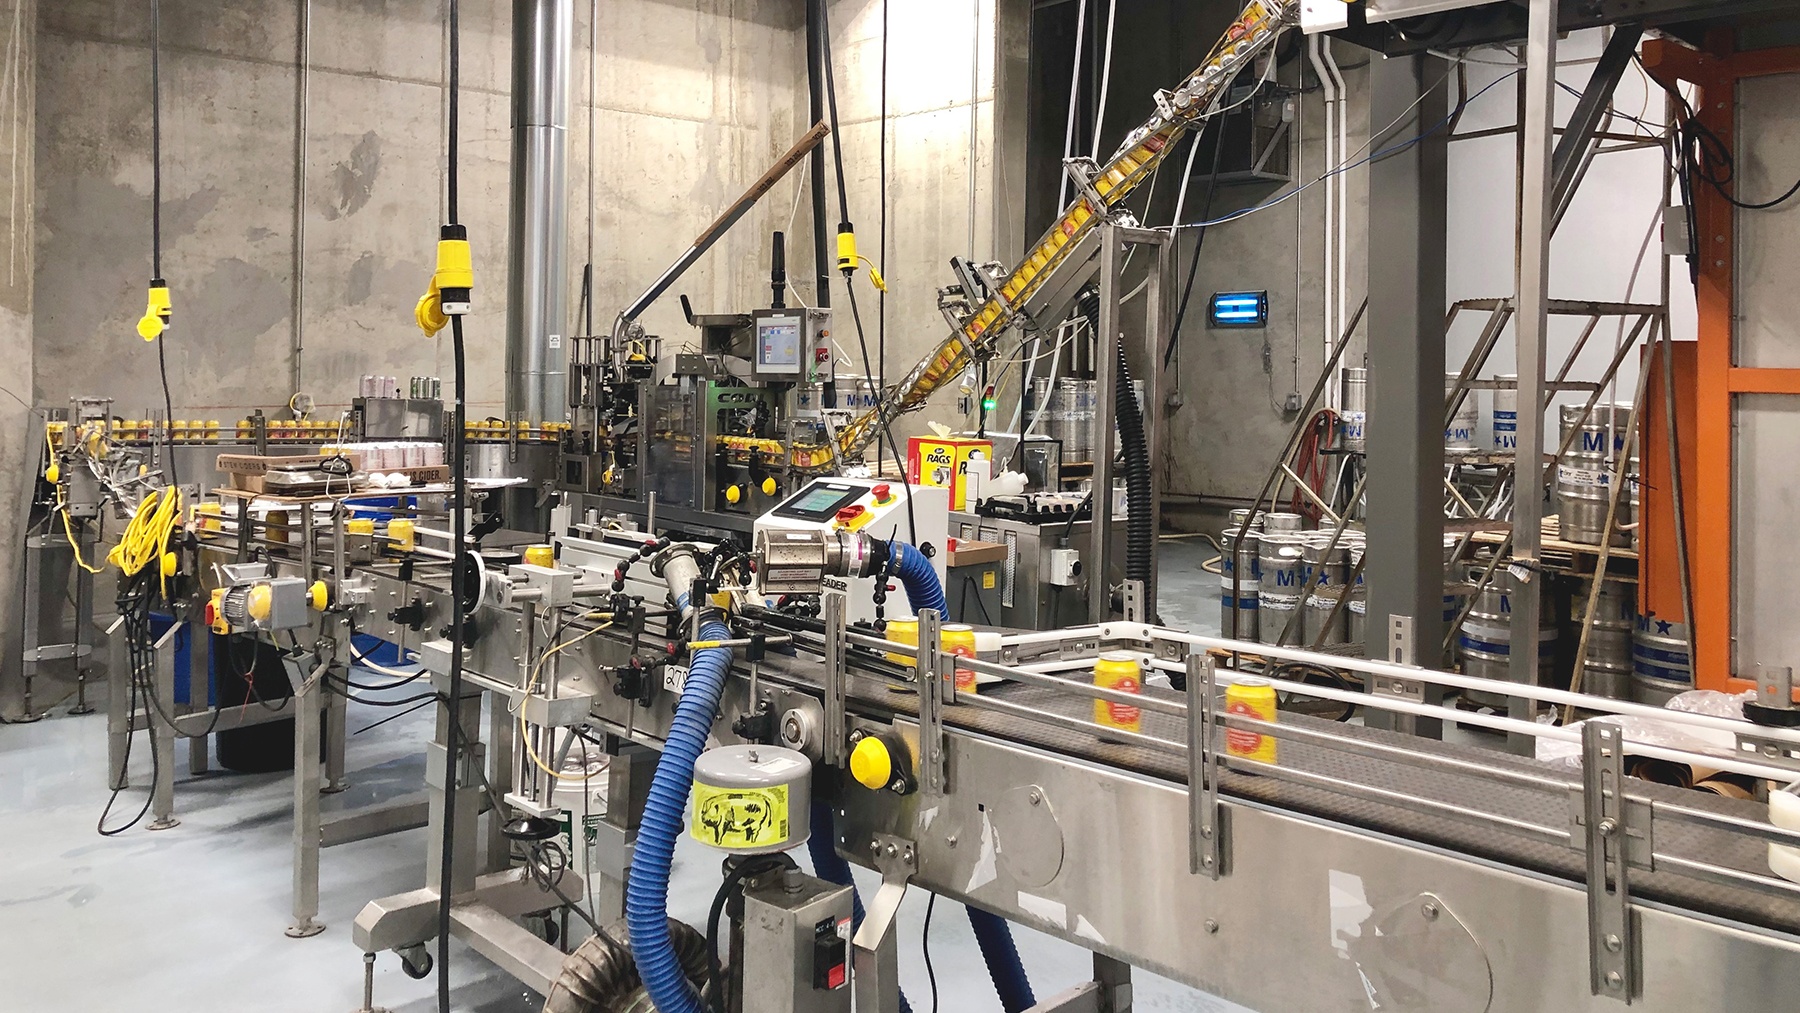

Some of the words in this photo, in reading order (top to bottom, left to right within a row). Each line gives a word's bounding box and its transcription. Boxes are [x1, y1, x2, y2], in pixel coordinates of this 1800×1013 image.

[1583, 432, 1603, 451] M
[927, 454, 951, 464] RAGS
[419, 470, 441, 481] CIDER.
[822, 578, 847, 592] EADER
[1277, 570, 1294, 587] M
